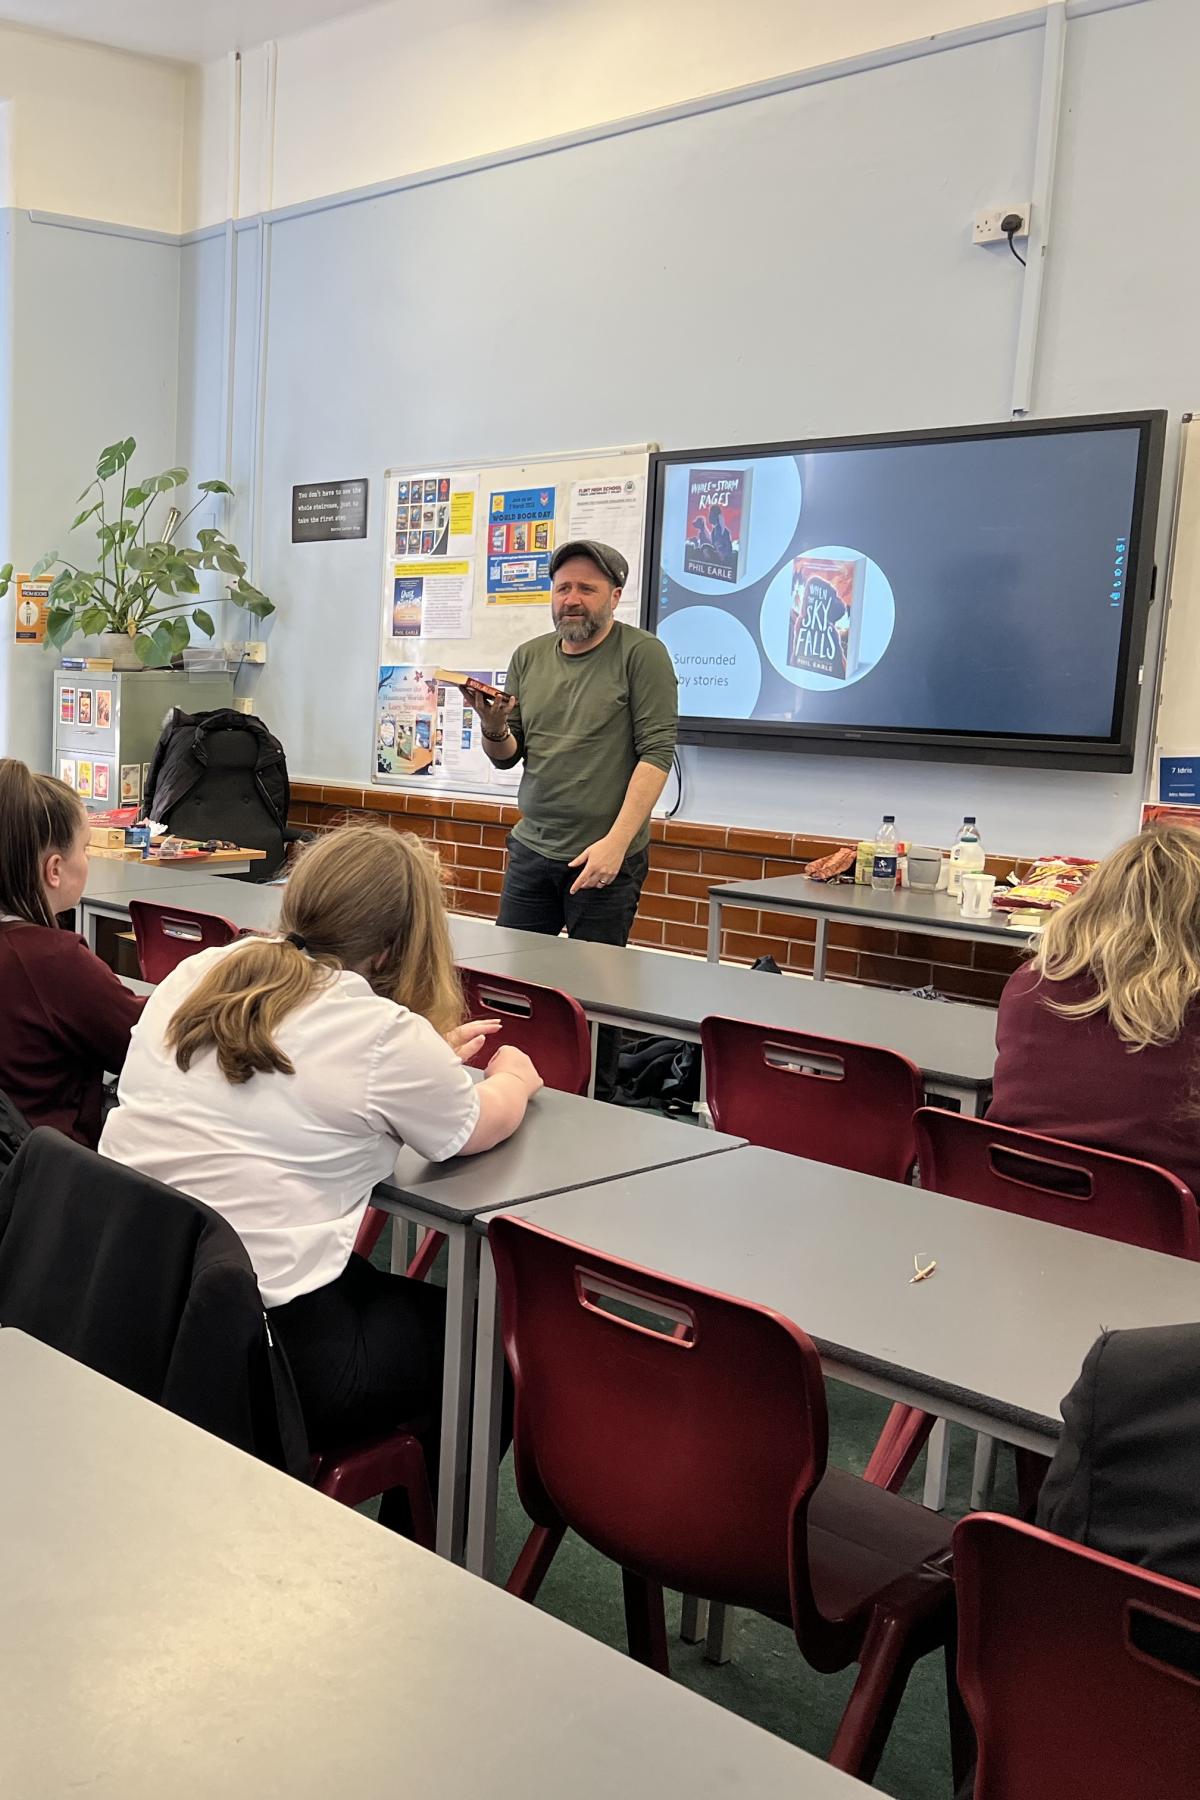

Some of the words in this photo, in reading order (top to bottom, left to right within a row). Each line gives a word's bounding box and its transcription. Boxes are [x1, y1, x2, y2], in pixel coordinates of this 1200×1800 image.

[691, 481, 711, 494] WHILE
[716, 479, 739, 492] STORM
[699, 492, 731, 510] RAGES
[517, 512, 537, 520] BOOK
[688, 562, 705, 574] PHIL
[707, 566, 732, 579] EARLE
[810, 584, 828, 600] WHEN
[802, 597, 832, 632] SKY
[795, 626, 836, 660] FALLS
[673, 654, 736, 665] Surrounded
[797, 658, 811, 668] PHIL
[812, 662, 832, 672] EARLE
[679, 674, 691, 687] by
[693, 675, 729, 686] stories
